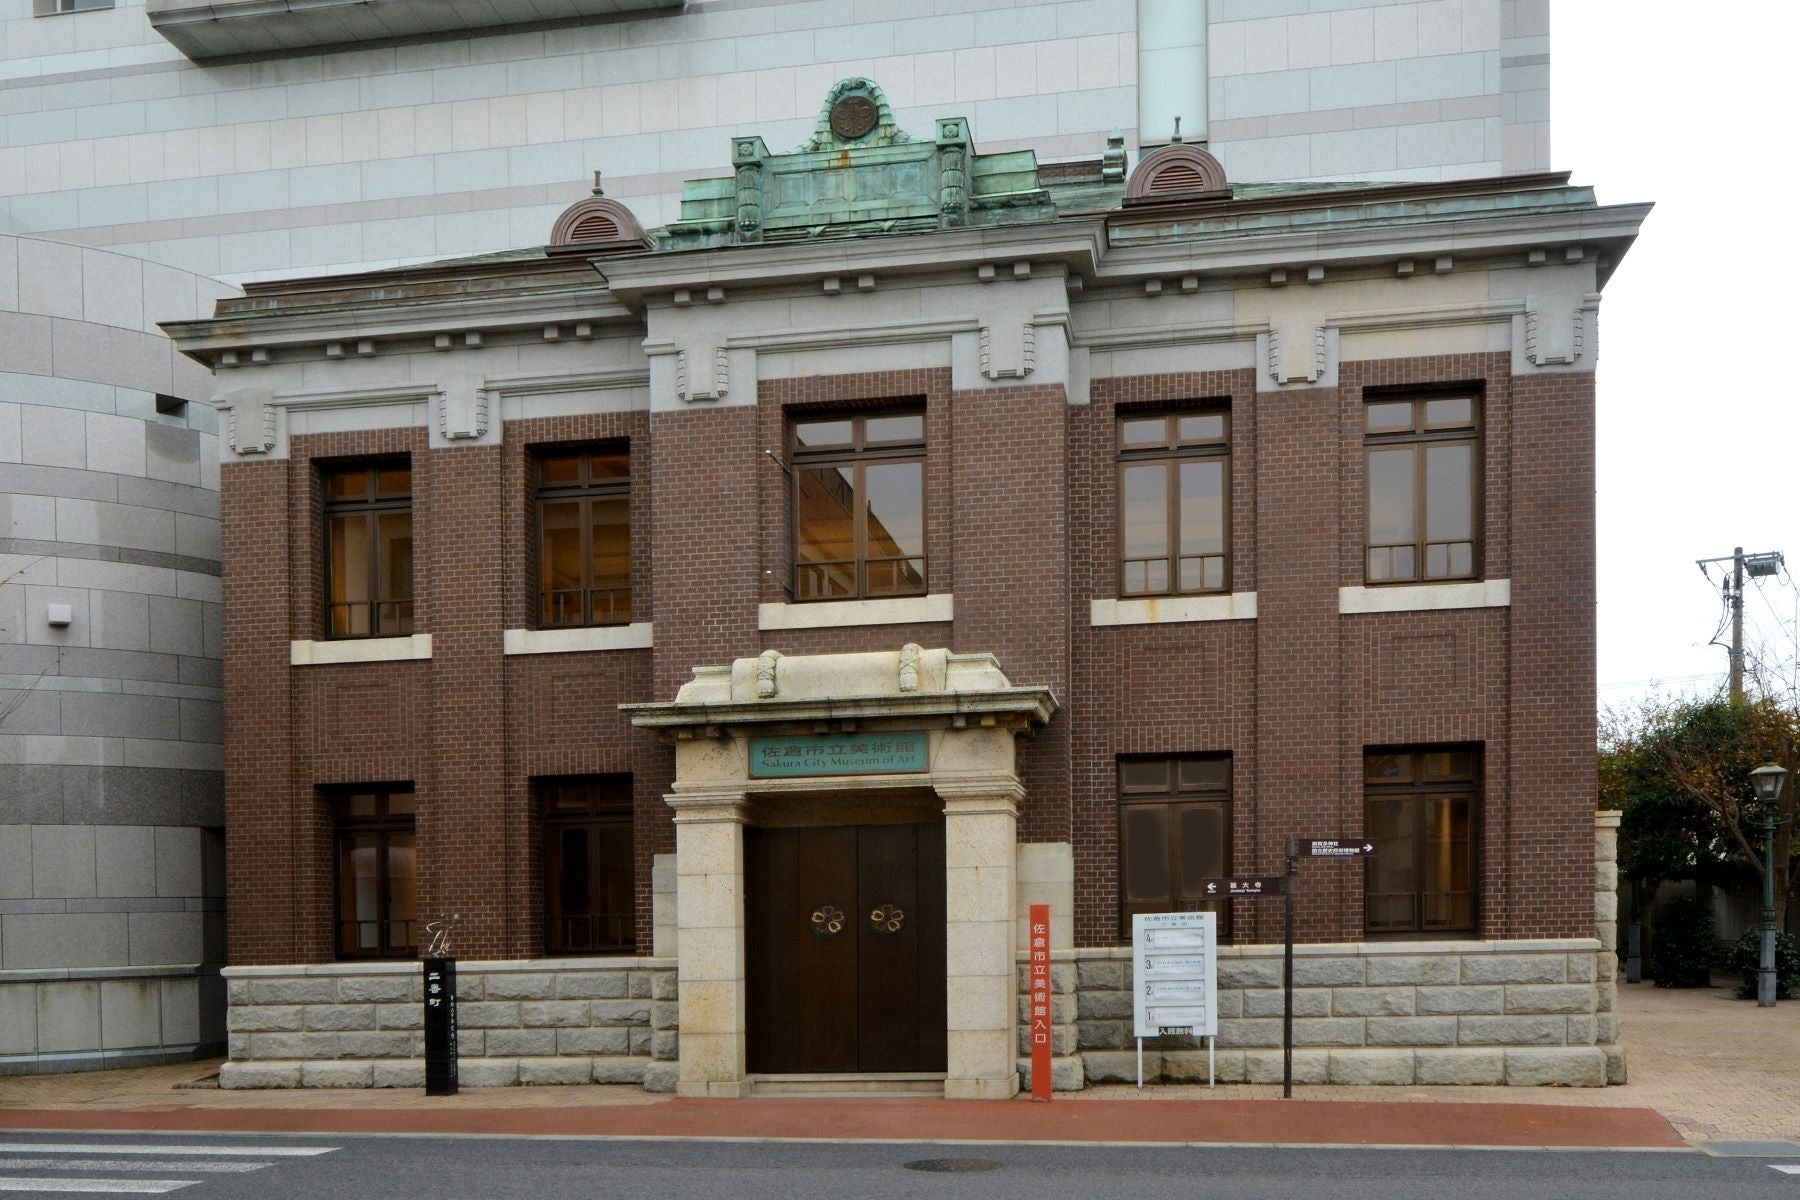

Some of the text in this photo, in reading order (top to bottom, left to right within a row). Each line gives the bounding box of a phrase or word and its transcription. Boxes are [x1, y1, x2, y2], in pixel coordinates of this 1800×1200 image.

[761, 742, 915, 758] 佐倉市立美術館
[762, 755, 915, 769] Sakura City Museum of Art
[428, 972, 441, 1007] 二番町
[1033, 923, 1046, 1043] 佐倉市立美術館入口
